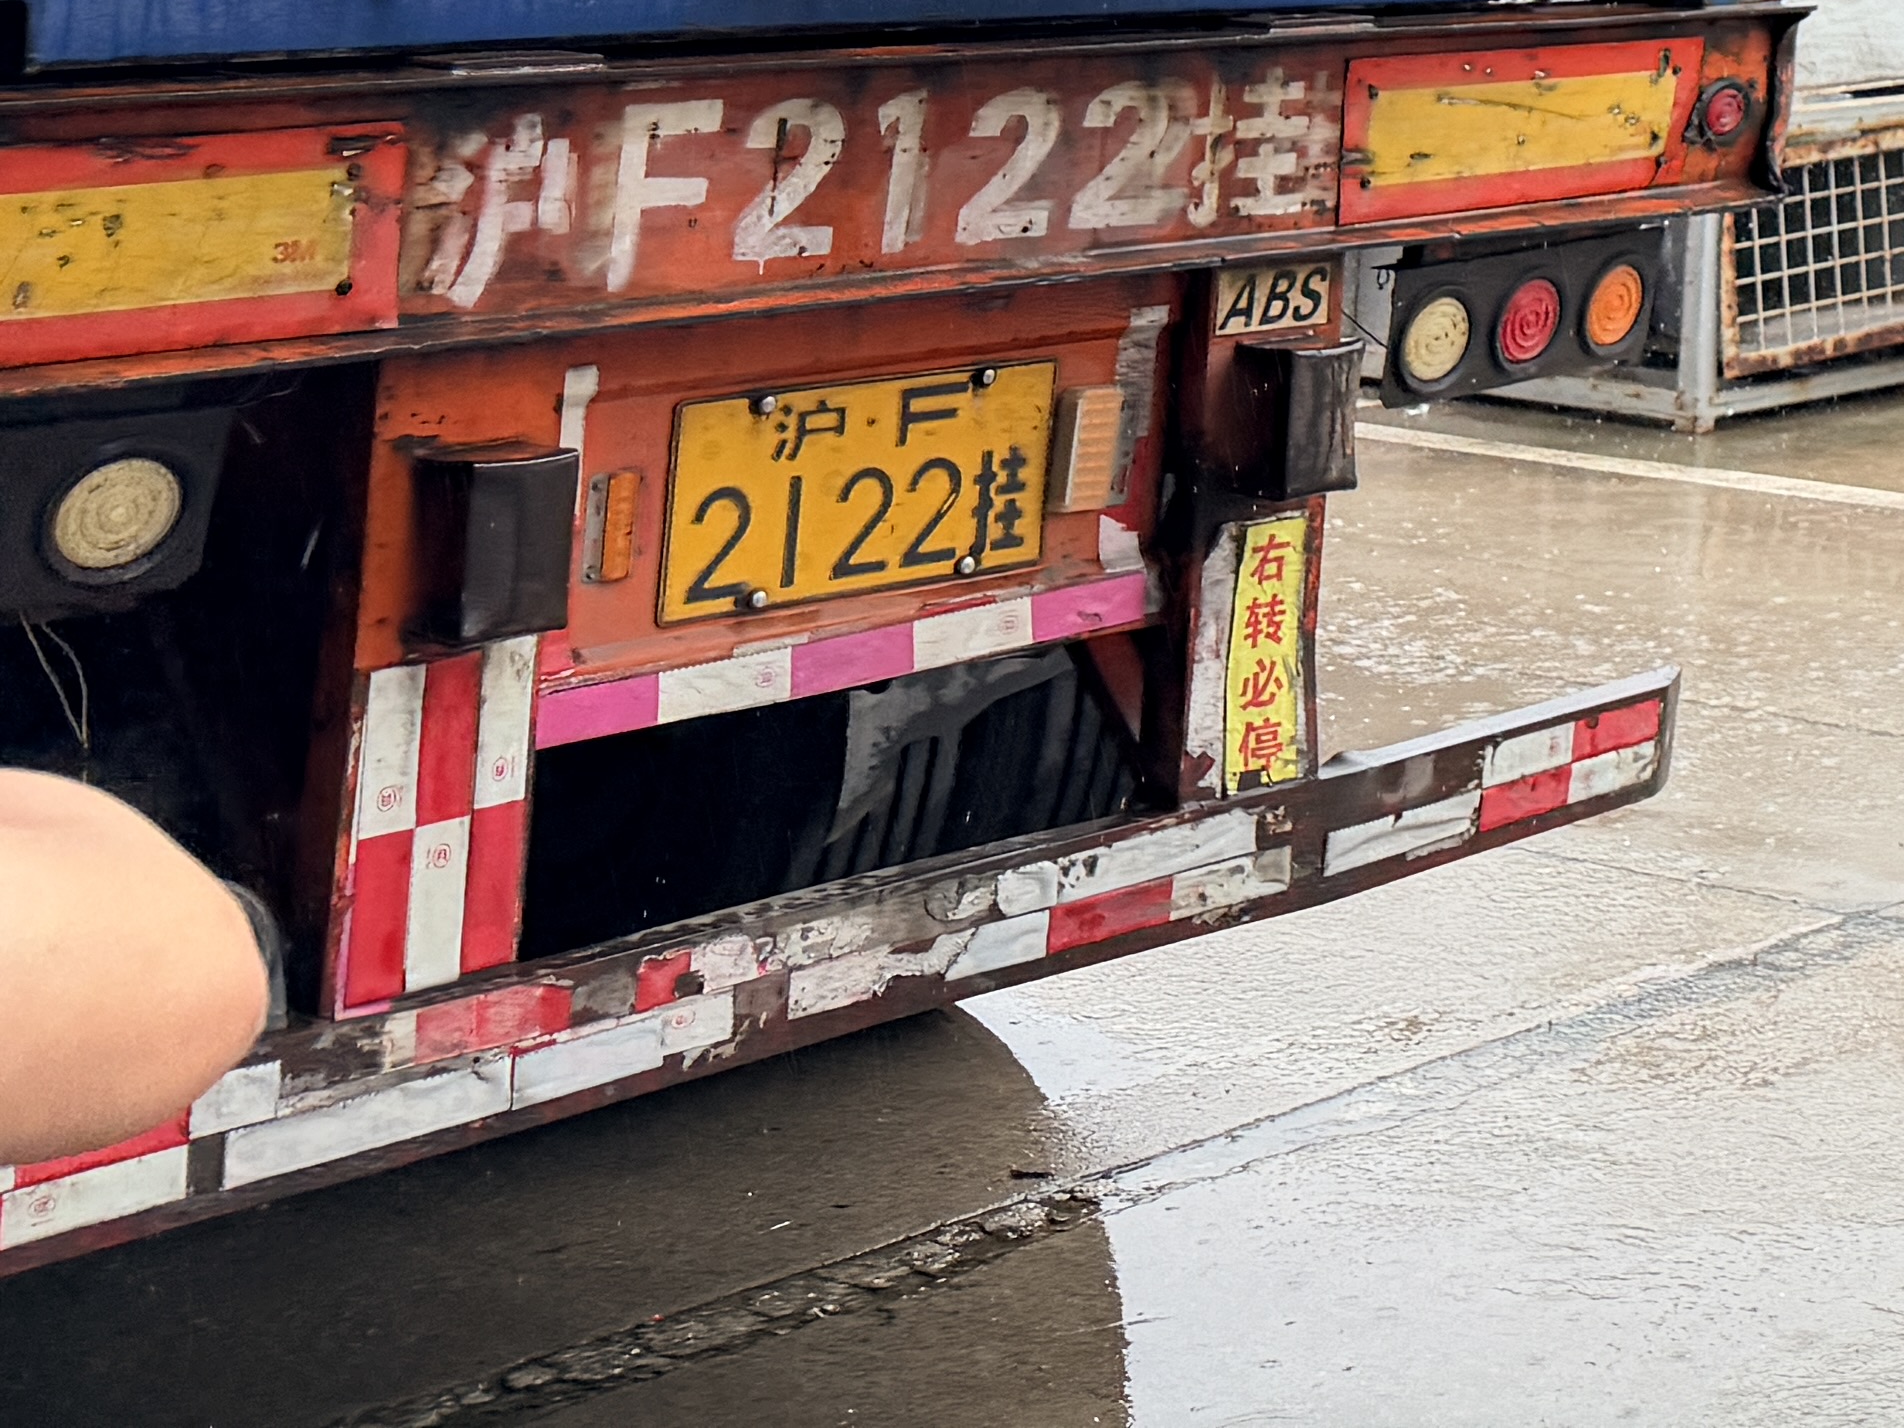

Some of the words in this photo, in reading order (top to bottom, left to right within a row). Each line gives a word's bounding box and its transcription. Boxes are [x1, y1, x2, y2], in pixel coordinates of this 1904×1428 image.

[1218, 266, 1327, 331] ABS
[685, 445, 1028, 605] 2122挂
[1238, 533, 1291, 772] 右转必停
